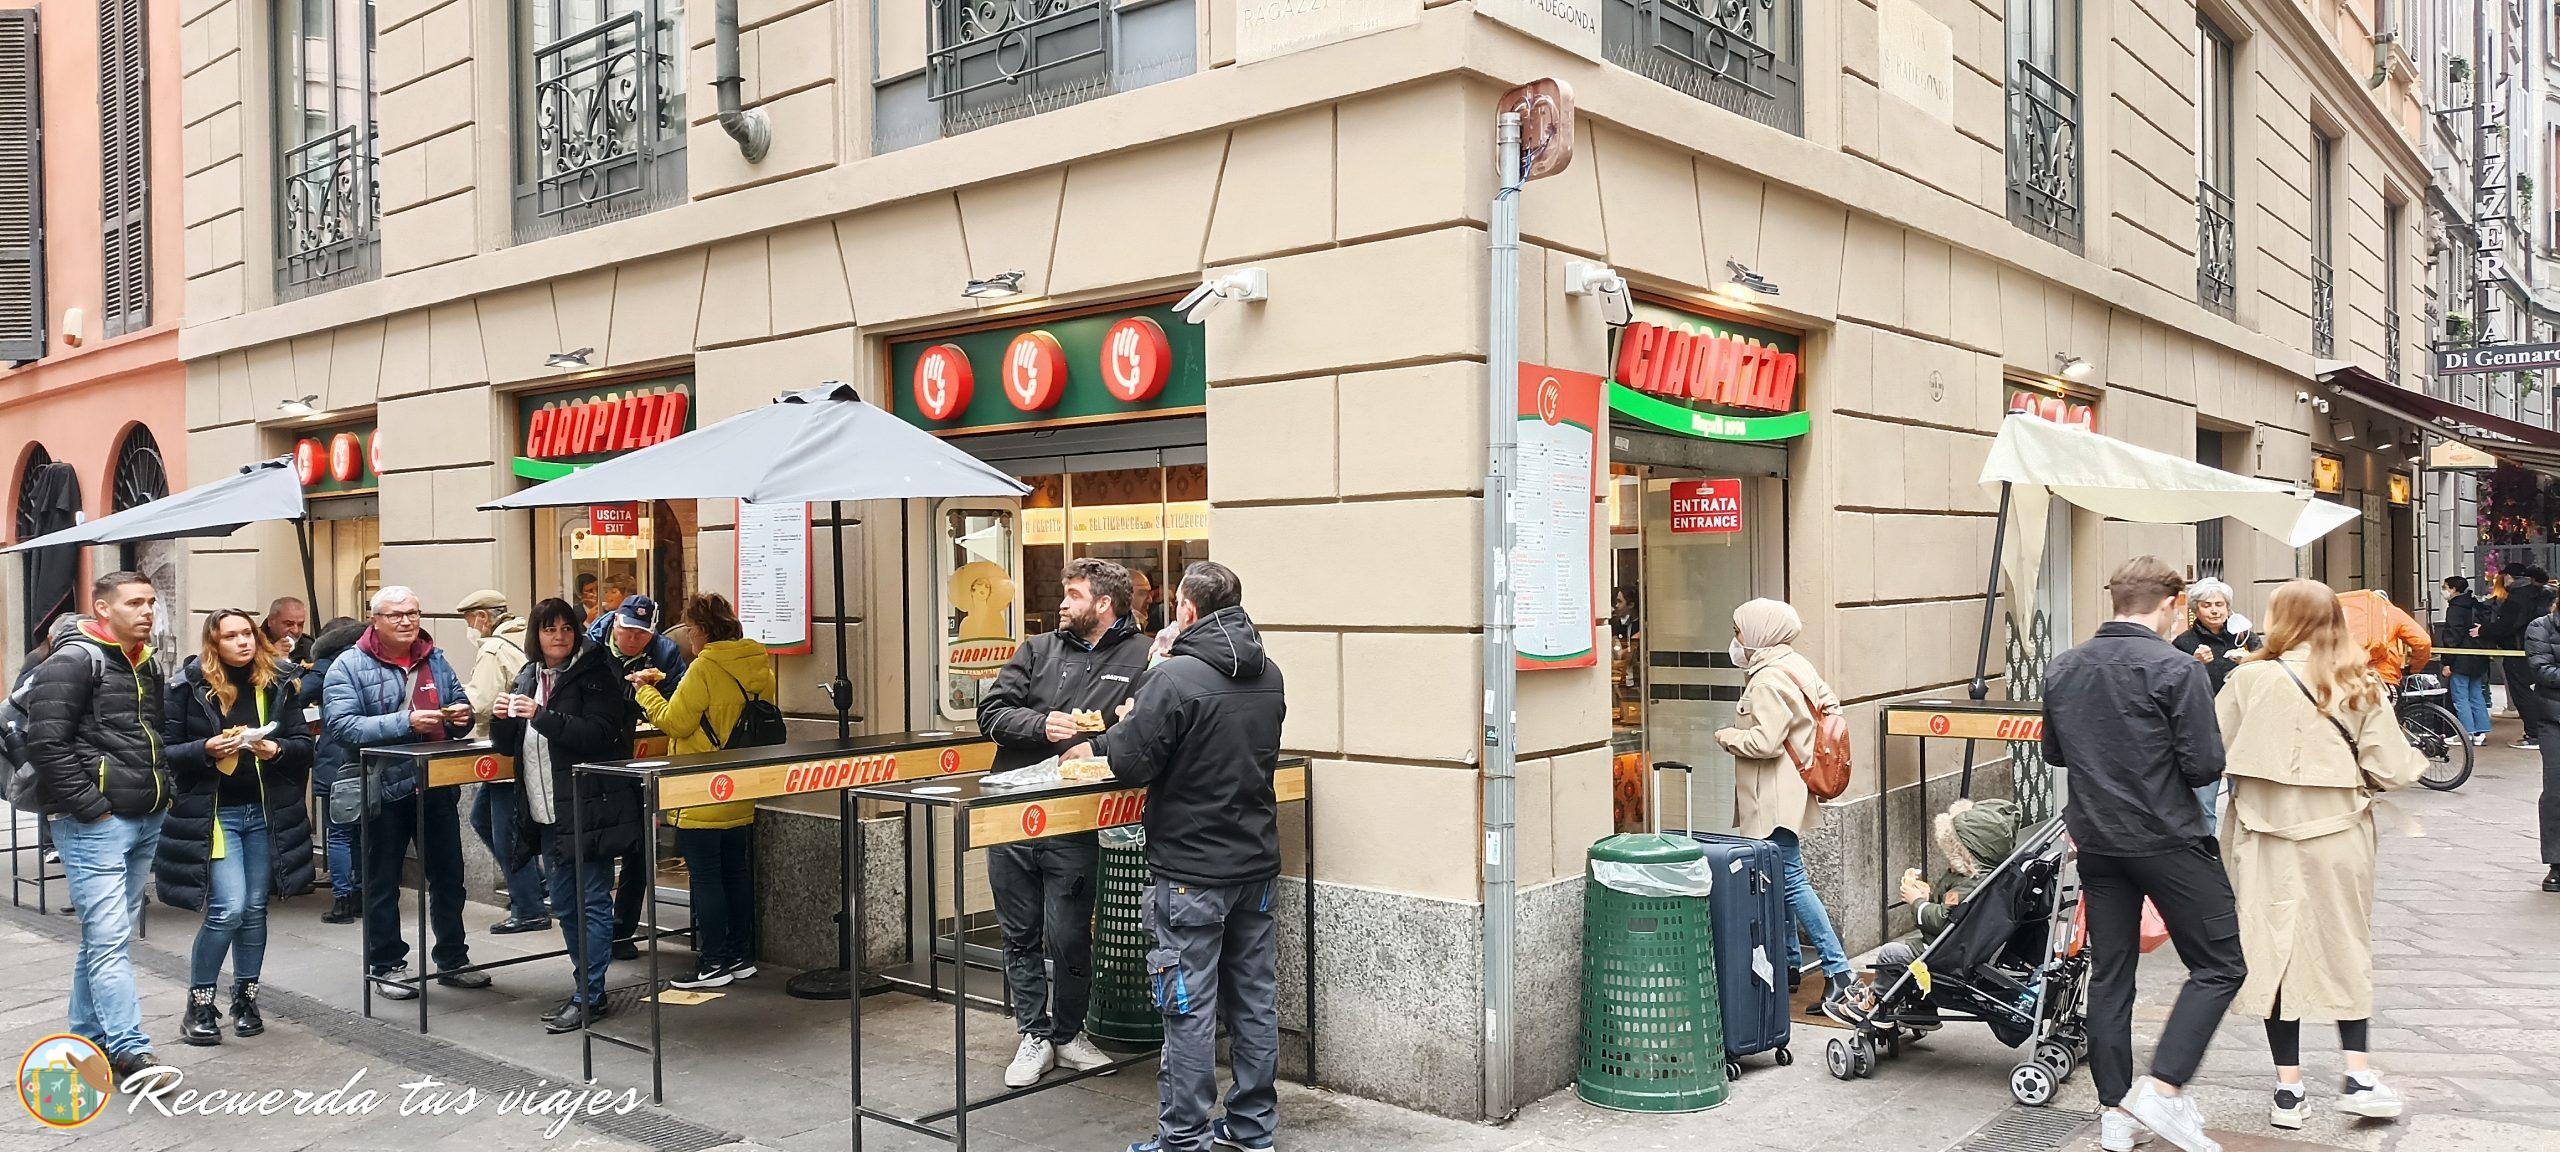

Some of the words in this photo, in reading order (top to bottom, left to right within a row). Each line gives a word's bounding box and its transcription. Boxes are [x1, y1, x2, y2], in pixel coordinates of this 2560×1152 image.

[2479, 101, 2509, 344] PIZZERIA
[1617, 321, 1798, 413] CIAOPIZZA
[2445, 353, 2469, 369] Di
[526, 390, 688, 459] CIAOPIZZA
[1673, 497, 1738, 513] ENTRATA
[596, 509, 632, 521] USCITA
[1673, 515, 1738, 529] ENTRANCE
[605, 523, 624, 533] EXIT
[950, 646, 1015, 664] CIAOPIZZA
[785, 758, 897, 793] CIAOPIZZA
